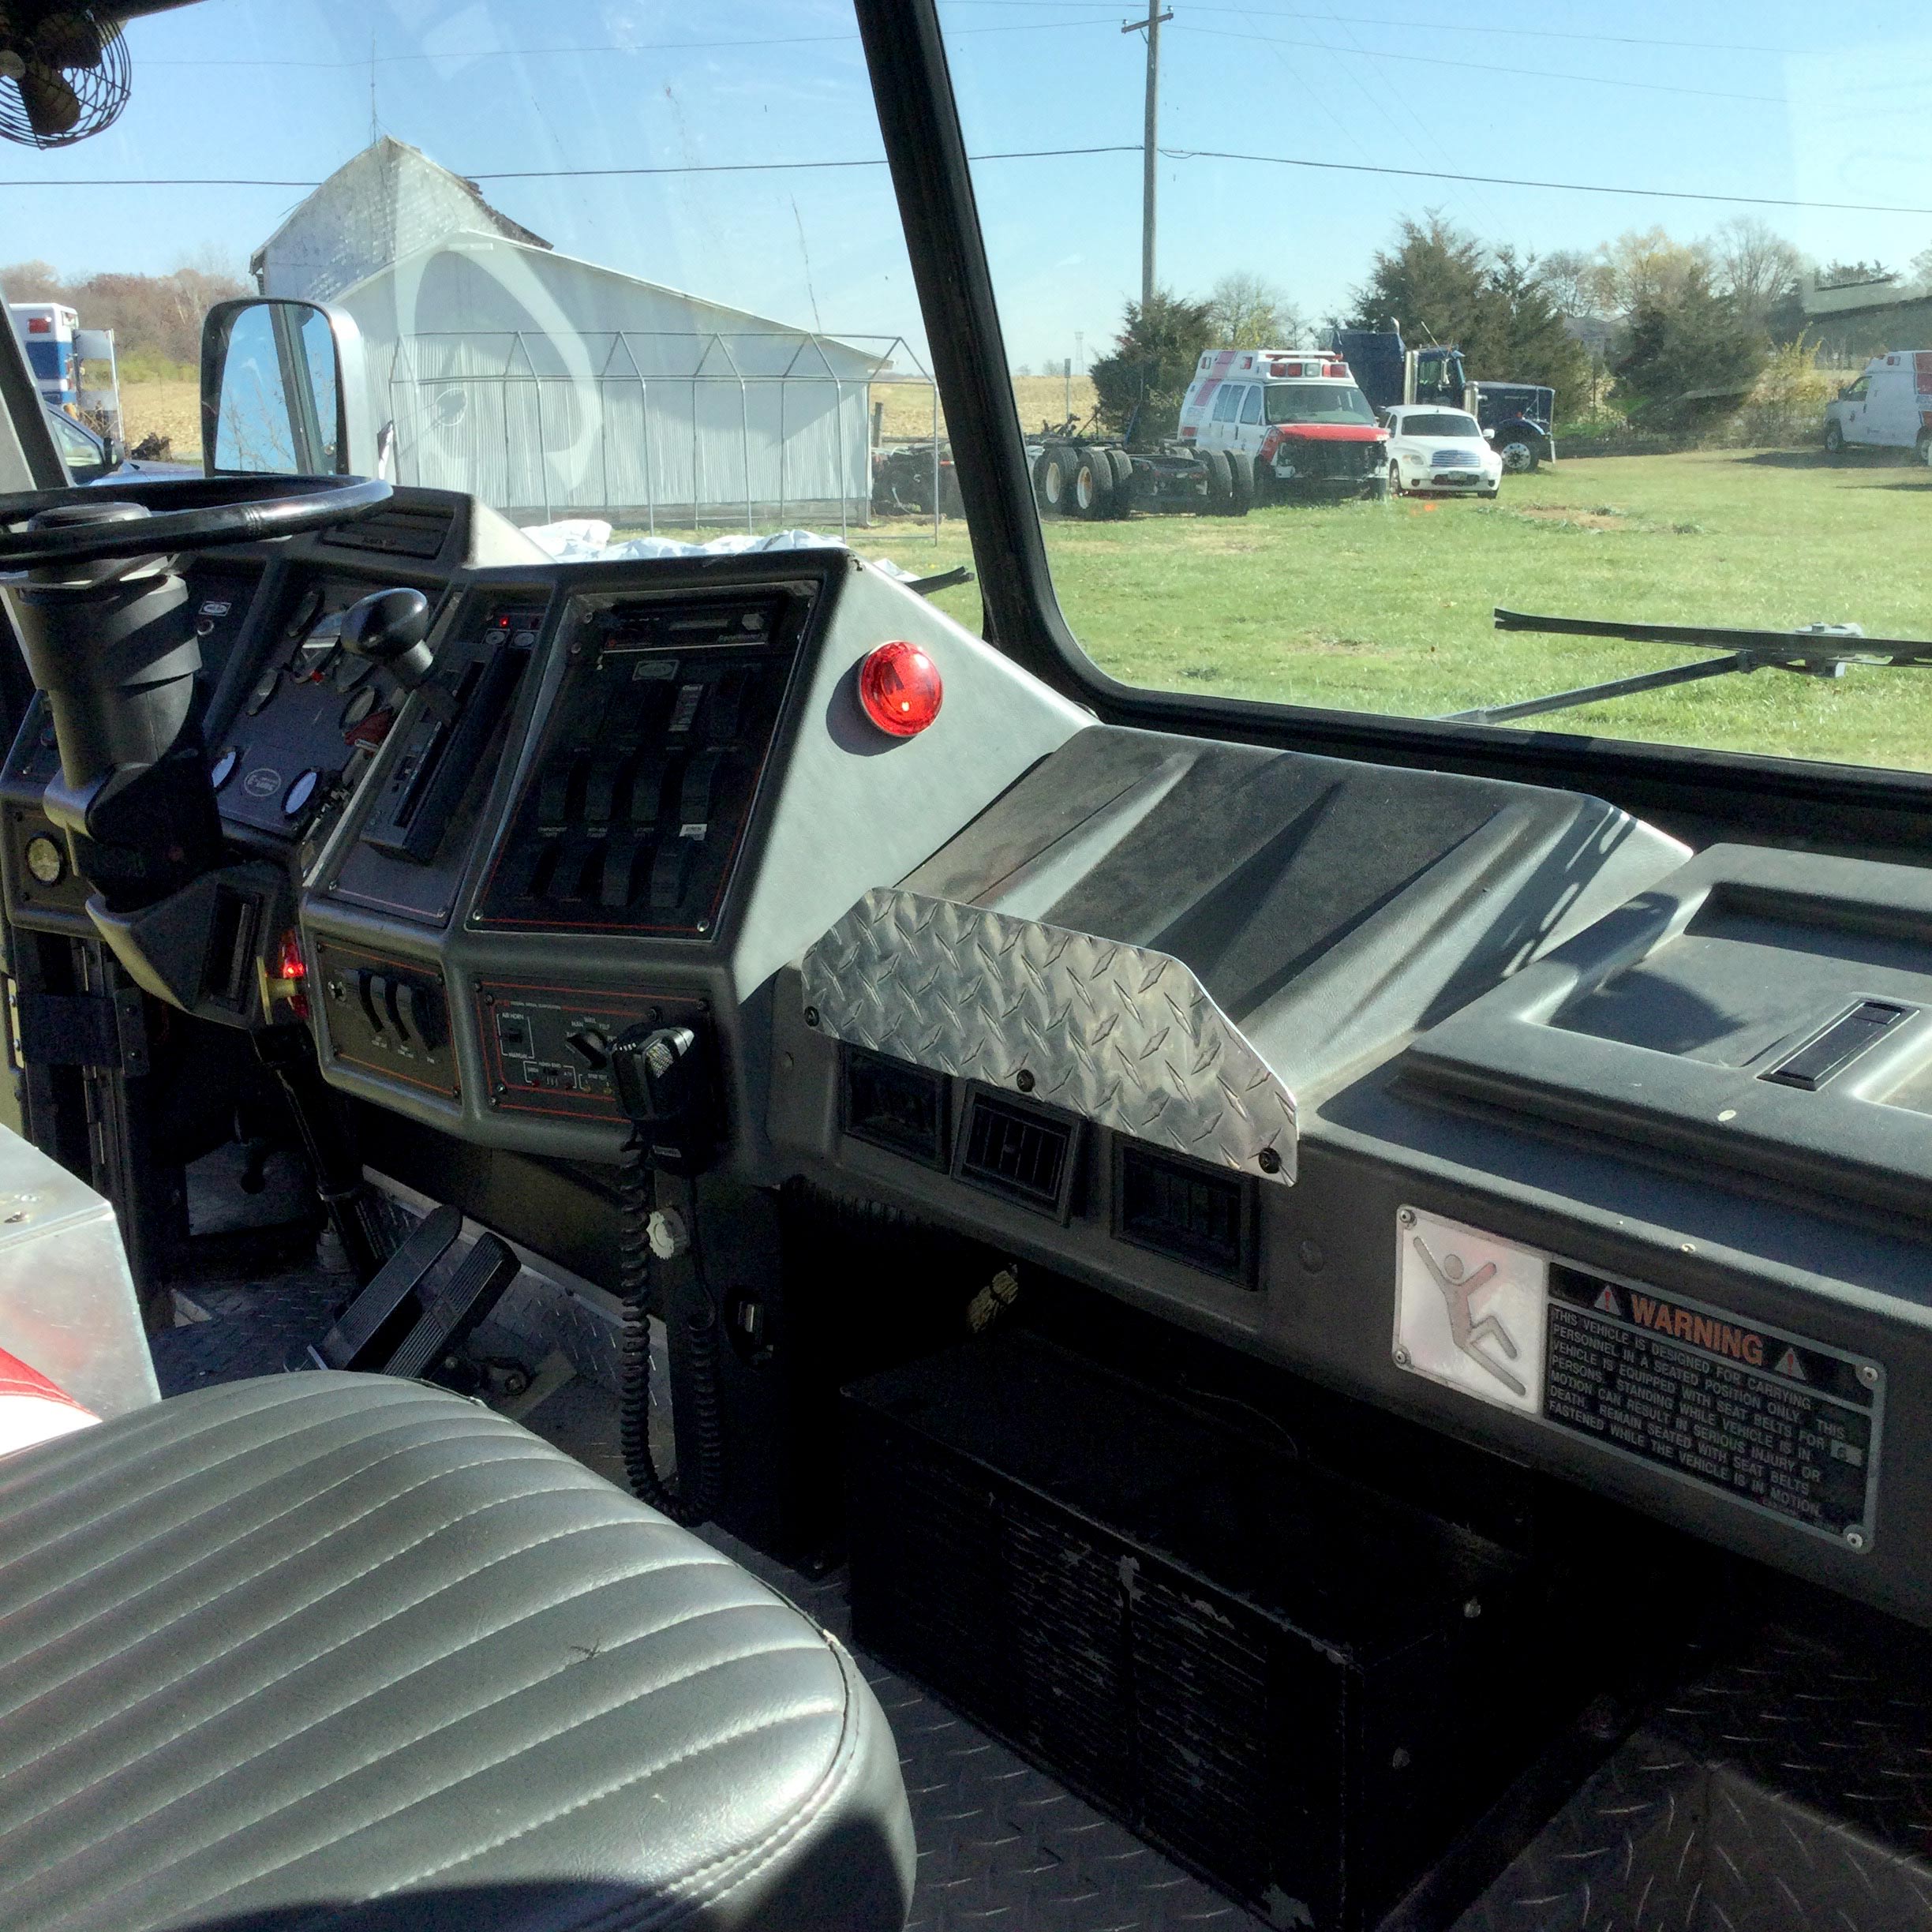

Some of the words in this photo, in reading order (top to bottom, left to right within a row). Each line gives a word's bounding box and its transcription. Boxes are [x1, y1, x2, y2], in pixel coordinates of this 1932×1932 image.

[1554, 1308, 1576, 1327] THIS
[1583, 1318, 1628, 1345] VEHICLE
[1634, 1336, 1646, 1351] IS
[1651, 1342, 1709, 1374] DESIGNED
[1717, 1365, 1741, 1386] FOR
[1747, 1376, 1811, 1411] CARRYING
[1631, 1294, 1762, 1367] WARNING
[1551, 1369, 1592, 1395] MOTION
[1597, 1387, 1621, 1406] CAN
[1627, 1398, 1670, 1425] RESULT
[1676, 1417, 1687, 1432] IN
[1693, 1423, 1744, 1454] SERIOUS
[1751, 1446, 1795, 1473] INJURY
[1802, 1465, 1820, 1483] OR
[1552, 1323, 1618, 1357] PERSONNEL
[1622, 1348, 1634, 1364] IN
[1640, 1354, 1649, 1368] A
[1653, 1359, 1698, 1387] SEATED
[1705, 1378, 1761, 1410] POSITION
[1818, 1418, 1845, 1441] THIS
[1552, 1339, 1597, 1365] VEHICLE
[1603, 1357, 1613, 1372] IS
[1619, 1363, 1676, 1395] EQUIPPED
[1681, 1386, 1710, 1408] WITH
[1717, 1399, 1747, 1421] SEAT
[1754, 1413, 1791, 1438] BELTS
[1799, 1429, 1824, 1451] FOR
[1616, 1379, 1673, 1410] STANDING
[1679, 1402, 1715, 1426] WHILE
[1722, 1418, 1773, 1448] VEHICLE
[1779, 1440, 1792, 1455] IS
[1798, 1447, 1810, 1462] IN
[1548, 1399, 1604, 1432] FASTENED
[1609, 1423, 1643, 1447] WHILE
[1650, 1439, 1673, 1459] THE
[1679, 1450, 1728, 1481] VEHICLE
[1734, 1471, 1745, 1488] IS
[1752, 1478, 1764, 1495] IN
[1599, 1404, 1642, 1431] REMAIN
[1647, 1422, 1690, 1450] SEATED
[1698, 1442, 1727, 1464] WITH
[1732, 1455, 1762, 1477] SEAT
[1771, 1470, 1808, 1496] BELTS
